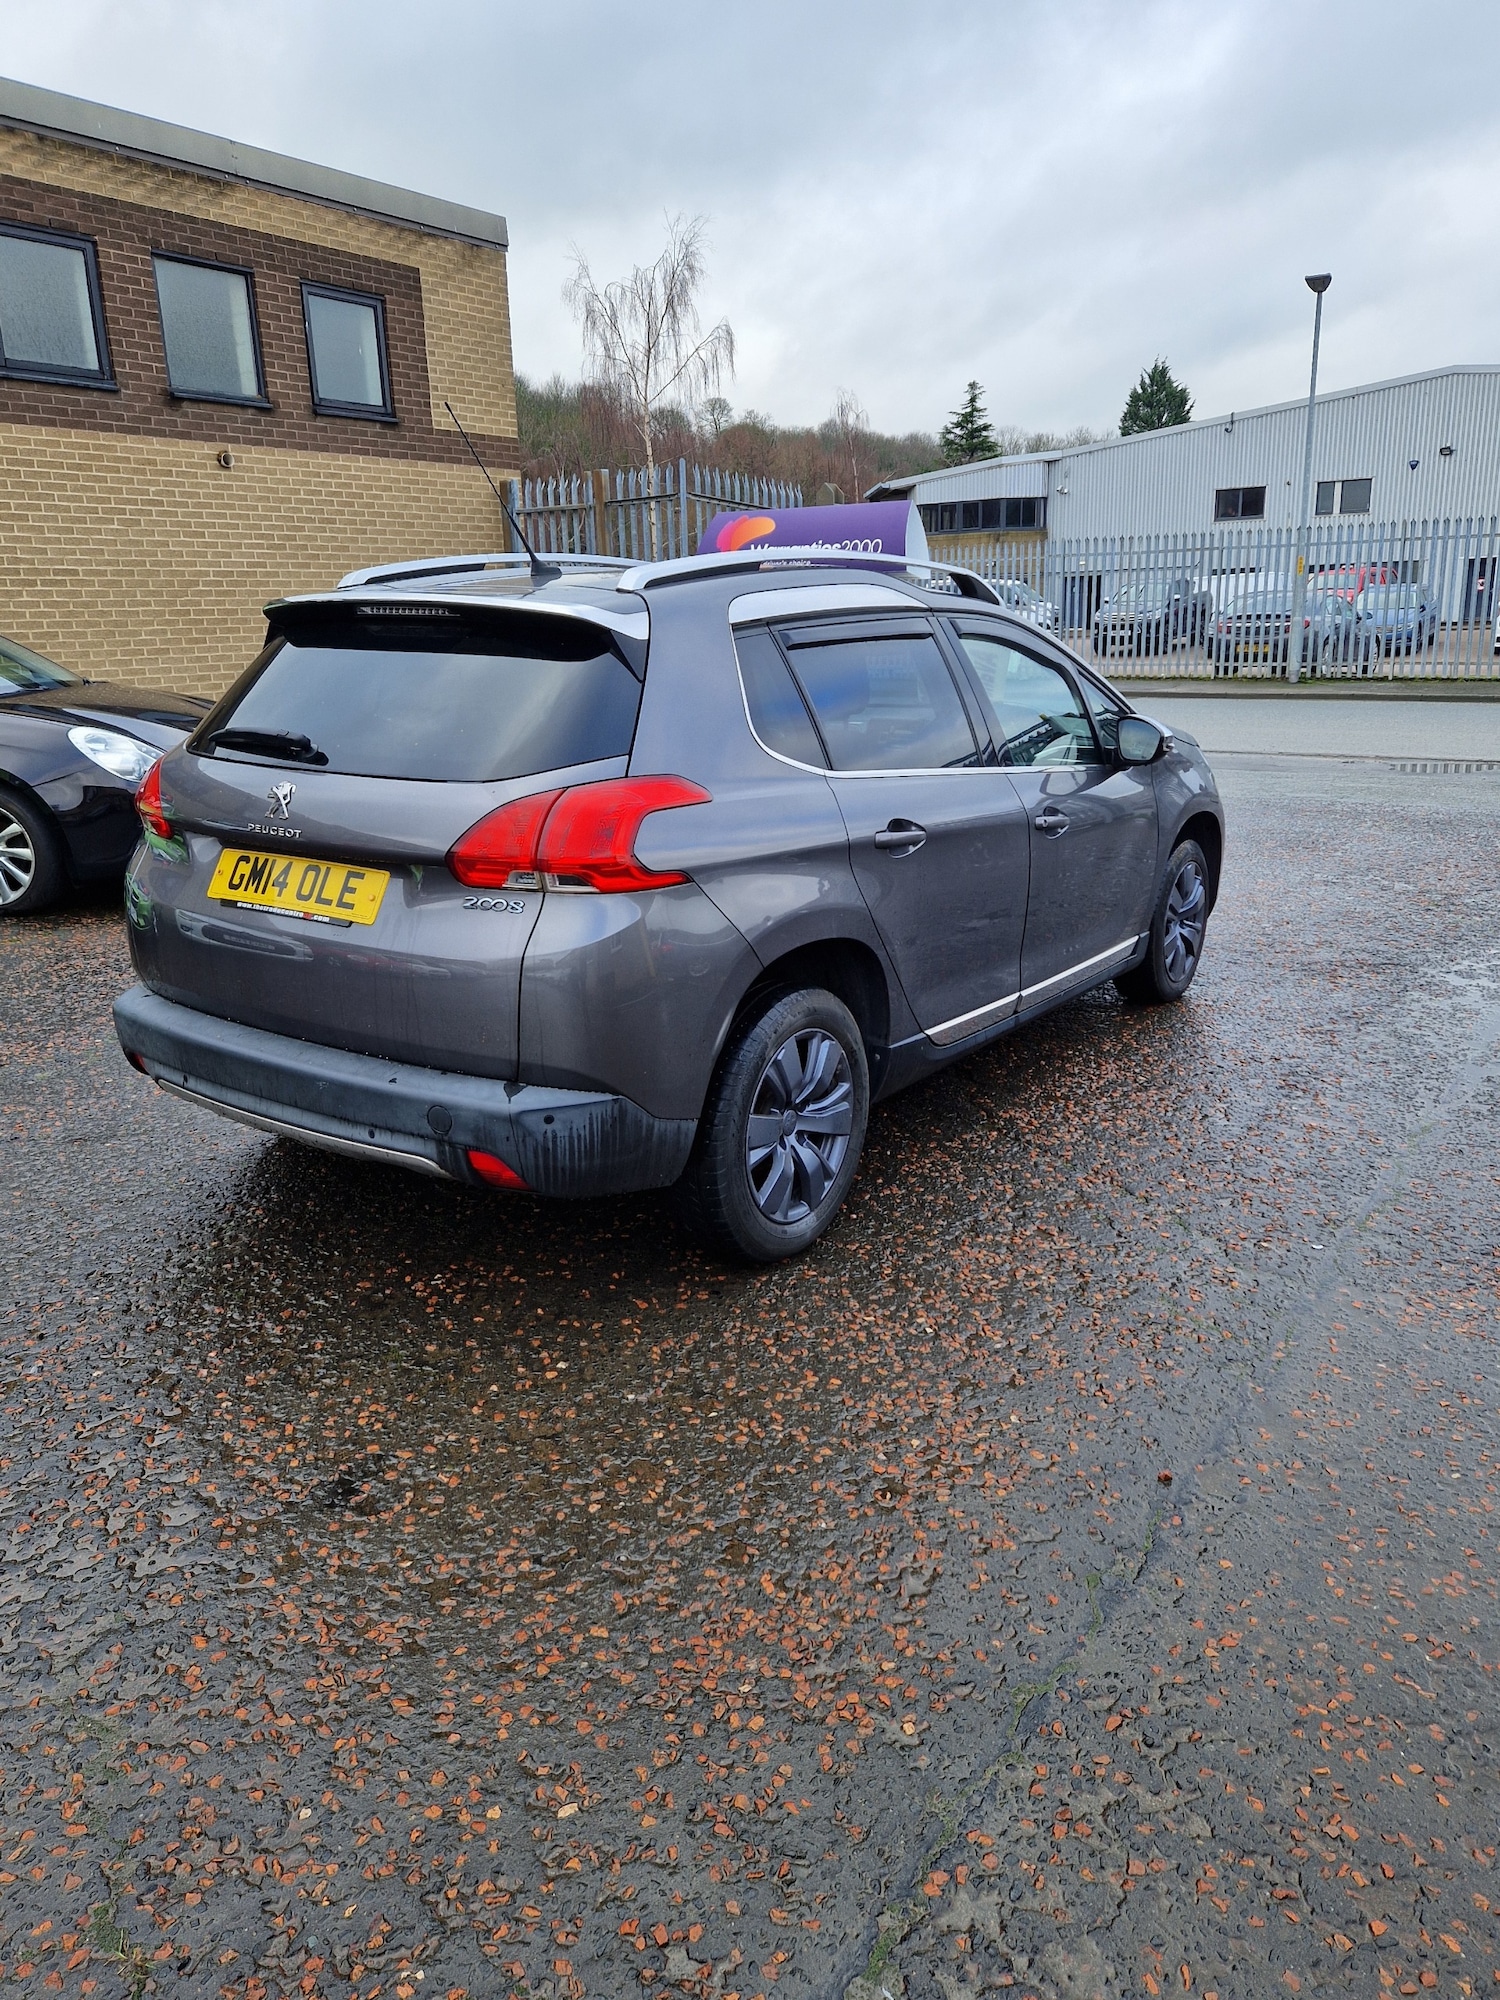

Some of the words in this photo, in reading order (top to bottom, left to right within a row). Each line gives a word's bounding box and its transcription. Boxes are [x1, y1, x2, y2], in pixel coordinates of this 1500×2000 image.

[750, 538, 883, 554] ties2000
[247, 823, 302, 838] PEUGEOT
[227, 855, 293, 898] GM14
[295, 864, 366, 911] OLE
[462, 895, 526, 914] 2008
